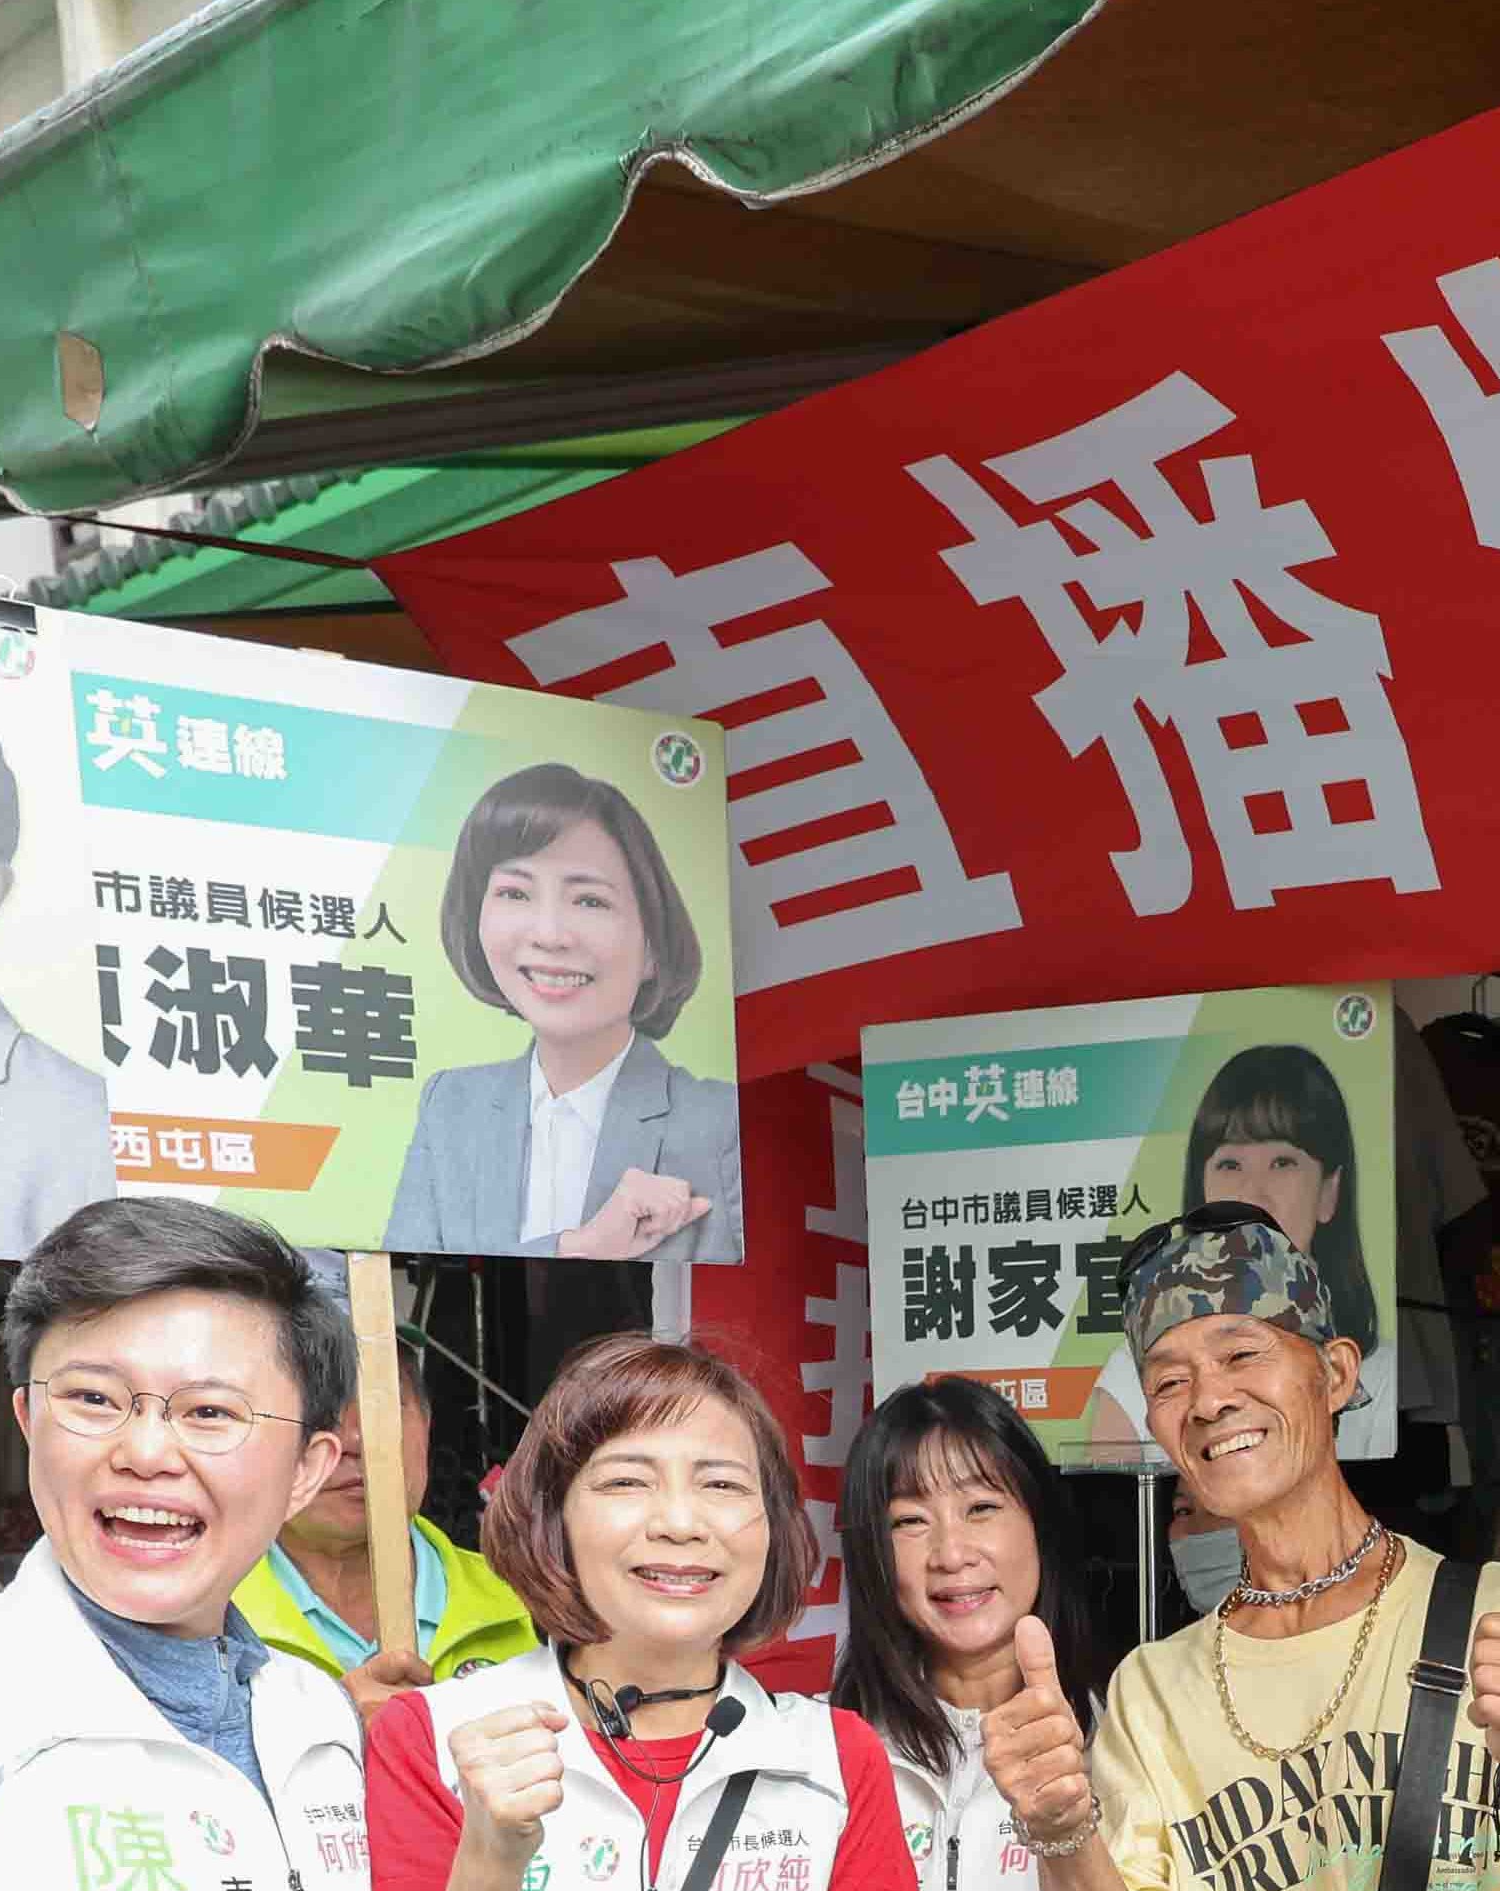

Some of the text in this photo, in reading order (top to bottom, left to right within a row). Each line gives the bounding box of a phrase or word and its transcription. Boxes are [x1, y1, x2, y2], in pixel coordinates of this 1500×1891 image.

[92, 868, 408, 945] 市議員候選人
[895, 1063, 1080, 1124] 台中英連線
[108, 1123, 257, 1175] 西屯區
[901, 1183, 1151, 1231] 台中市議員候選人
[687, 1828, 810, 1852] 台市長候選人
